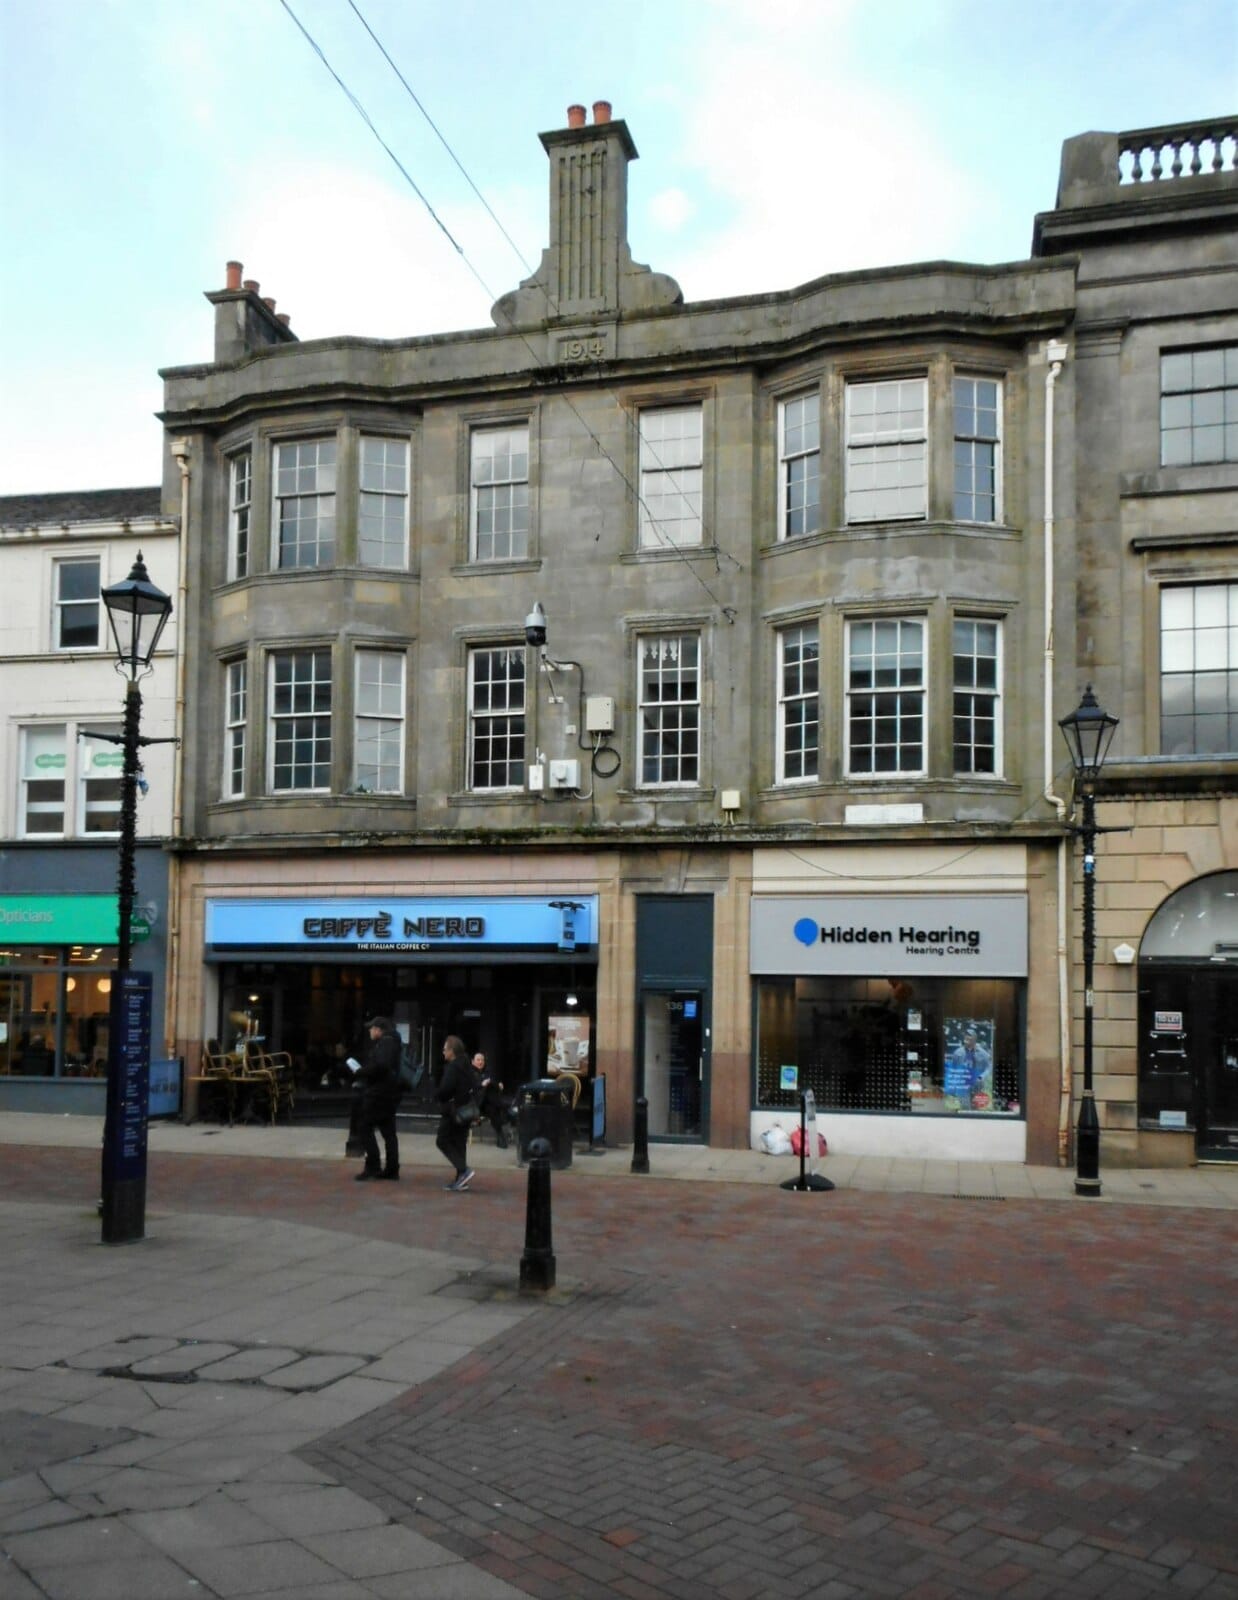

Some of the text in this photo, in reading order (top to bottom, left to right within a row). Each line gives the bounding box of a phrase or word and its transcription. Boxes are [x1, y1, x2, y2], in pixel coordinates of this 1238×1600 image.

[563, 338, 604, 360] 1914
[403, 916, 486, 938] NERO
[821, 926, 980, 947] Hidden Hearing
[906, 946, 980, 956] Hearing Centre
